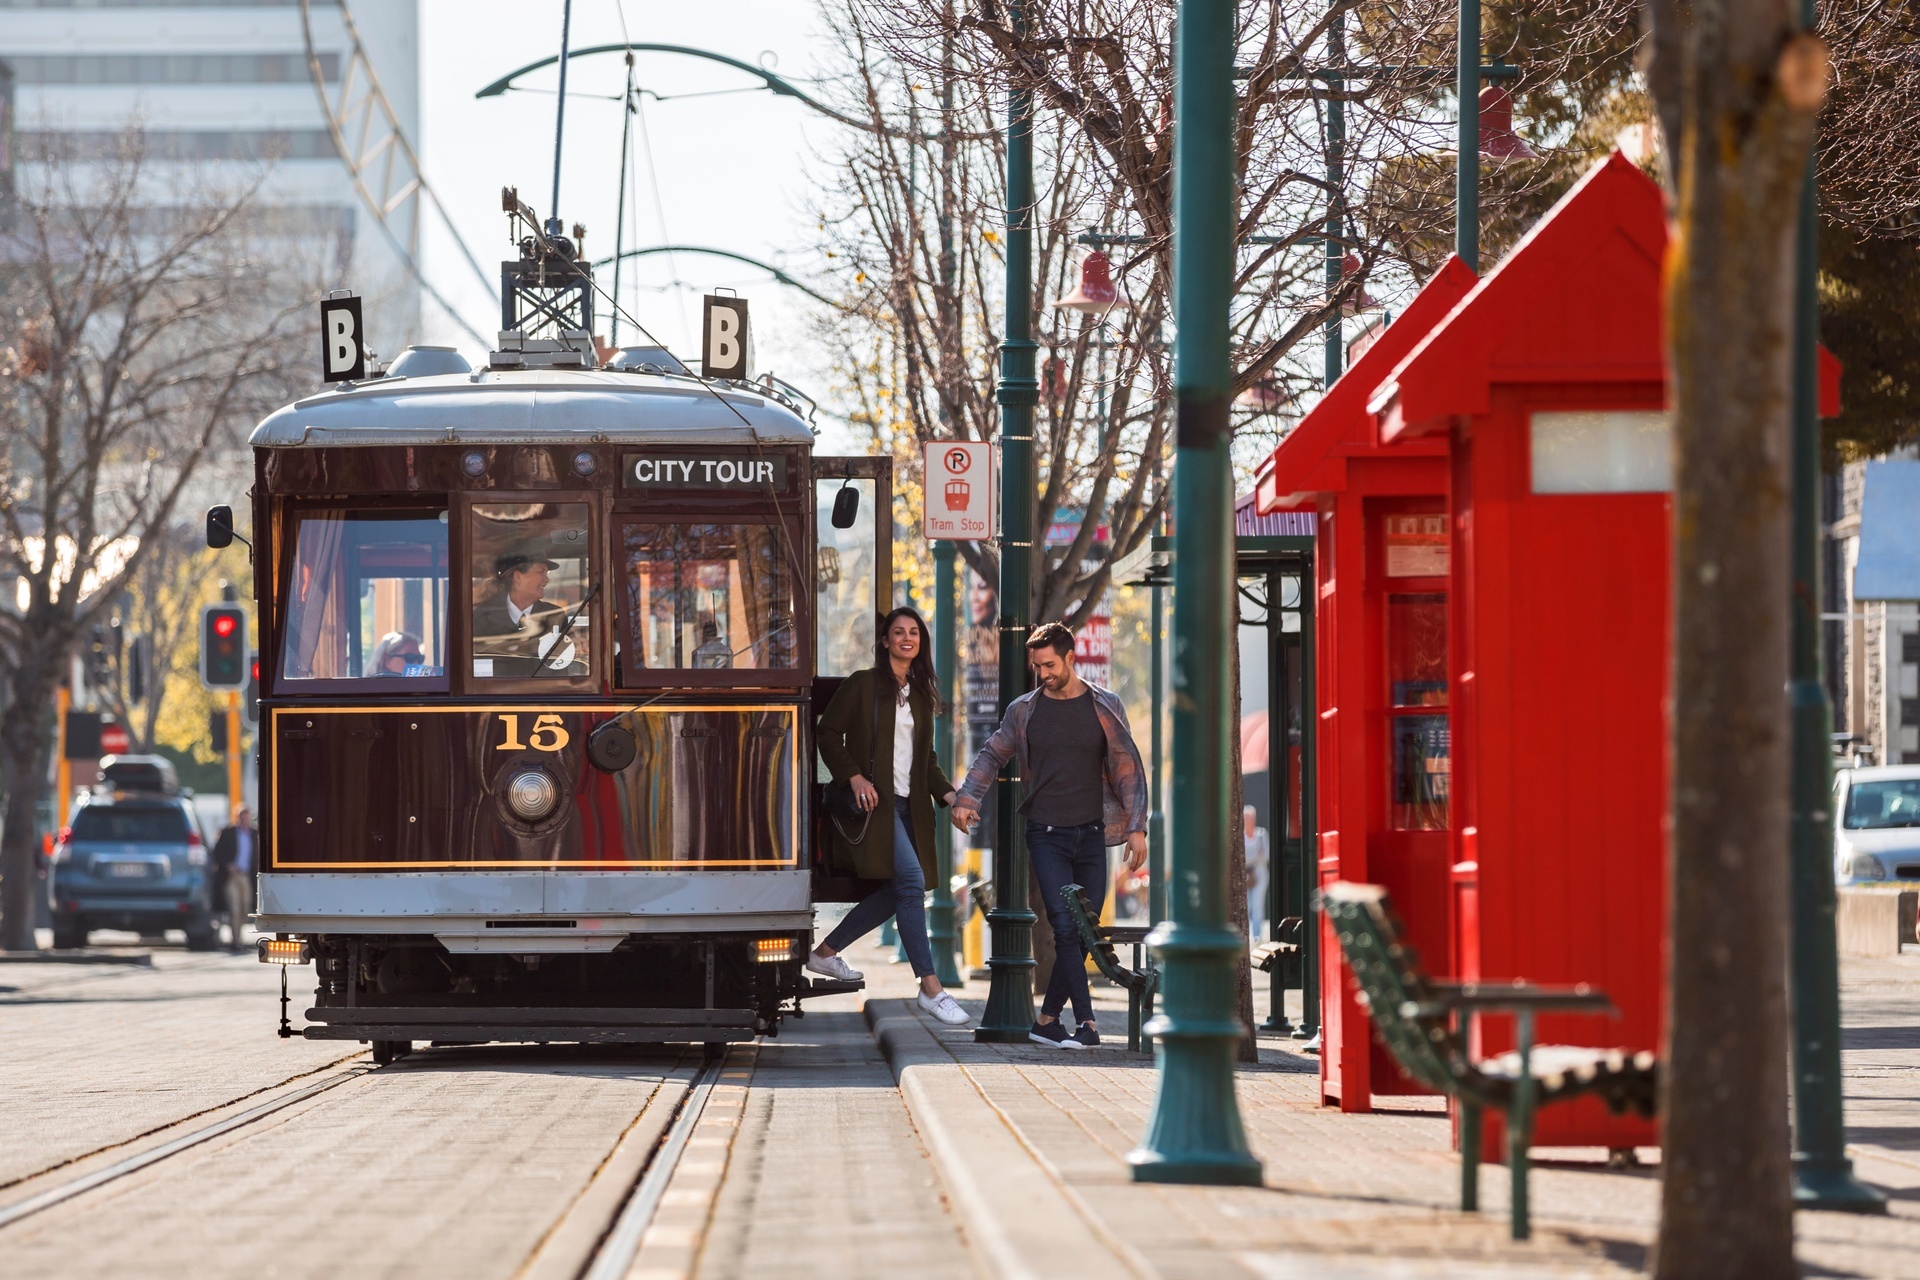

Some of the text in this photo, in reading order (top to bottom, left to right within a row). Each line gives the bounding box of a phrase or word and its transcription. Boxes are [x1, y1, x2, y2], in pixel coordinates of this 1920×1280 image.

[327, 308, 358, 374] B
[709, 305, 741, 370] B
[635, 459, 774, 483] CITY TOUR
[930, 517, 985, 533] Tram Stop
[496, 714, 570, 752] 15
